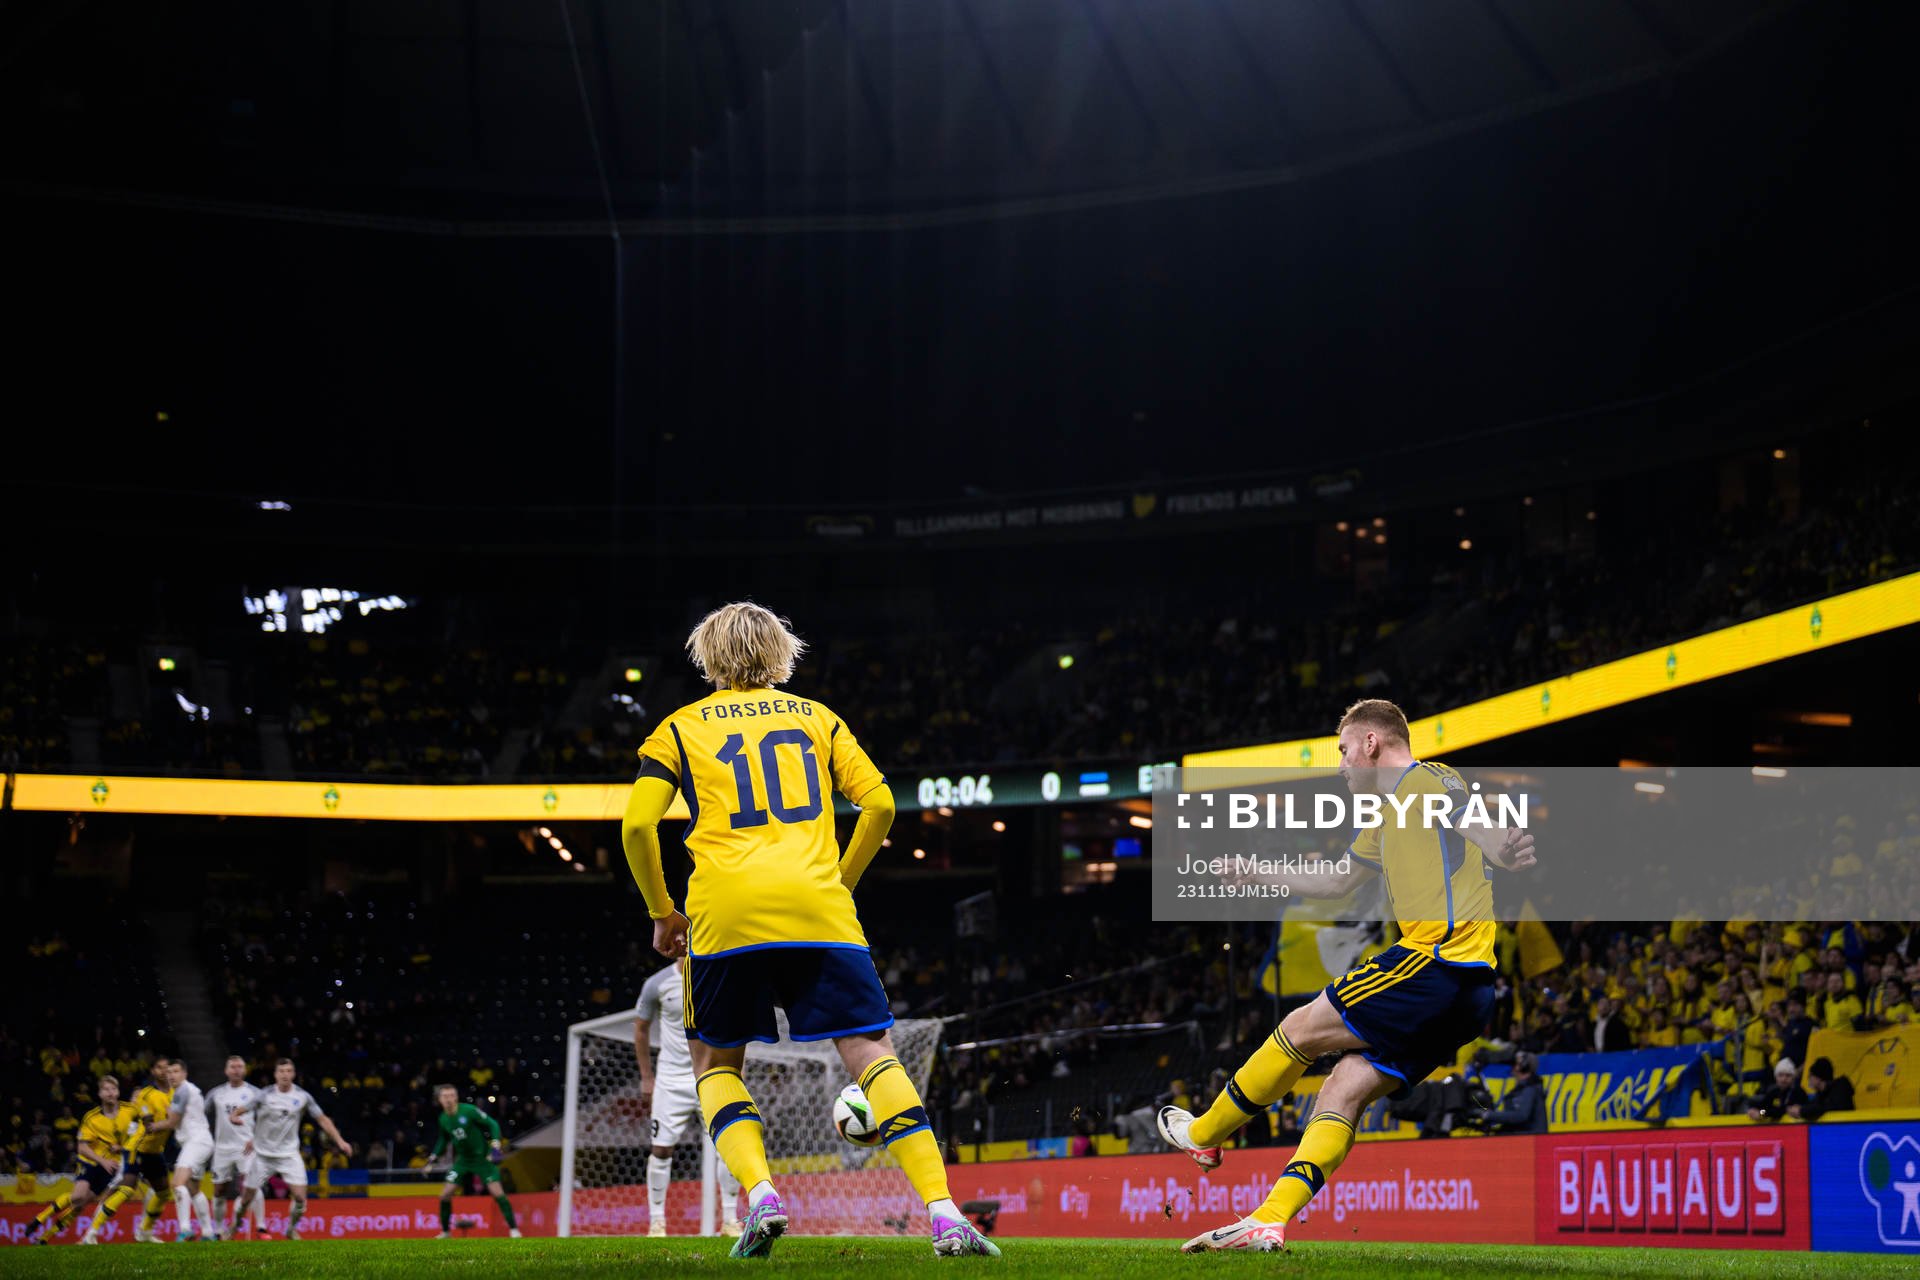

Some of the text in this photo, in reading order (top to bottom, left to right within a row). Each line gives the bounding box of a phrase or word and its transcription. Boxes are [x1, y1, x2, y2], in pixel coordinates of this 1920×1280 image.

[700, 699, 813, 721] FORSBERG
[715, 728, 824, 830] 10
[917, 774, 994, 808] 03:04
[1041, 771, 1061, 801] 0
[1138, 761, 1177, 793] EST
[1120, 1178, 1164, 1223] Apple
[1198, 1175, 1230, 1214] Den
[1231, 1173, 1273, 1213] enkl
[1334, 1181, 1400, 1223] genom
[1404, 1168, 1479, 1211] kassan.
[1559, 1157, 1779, 1218] BAUHAUS
[330, 1214, 411, 1236] genom
